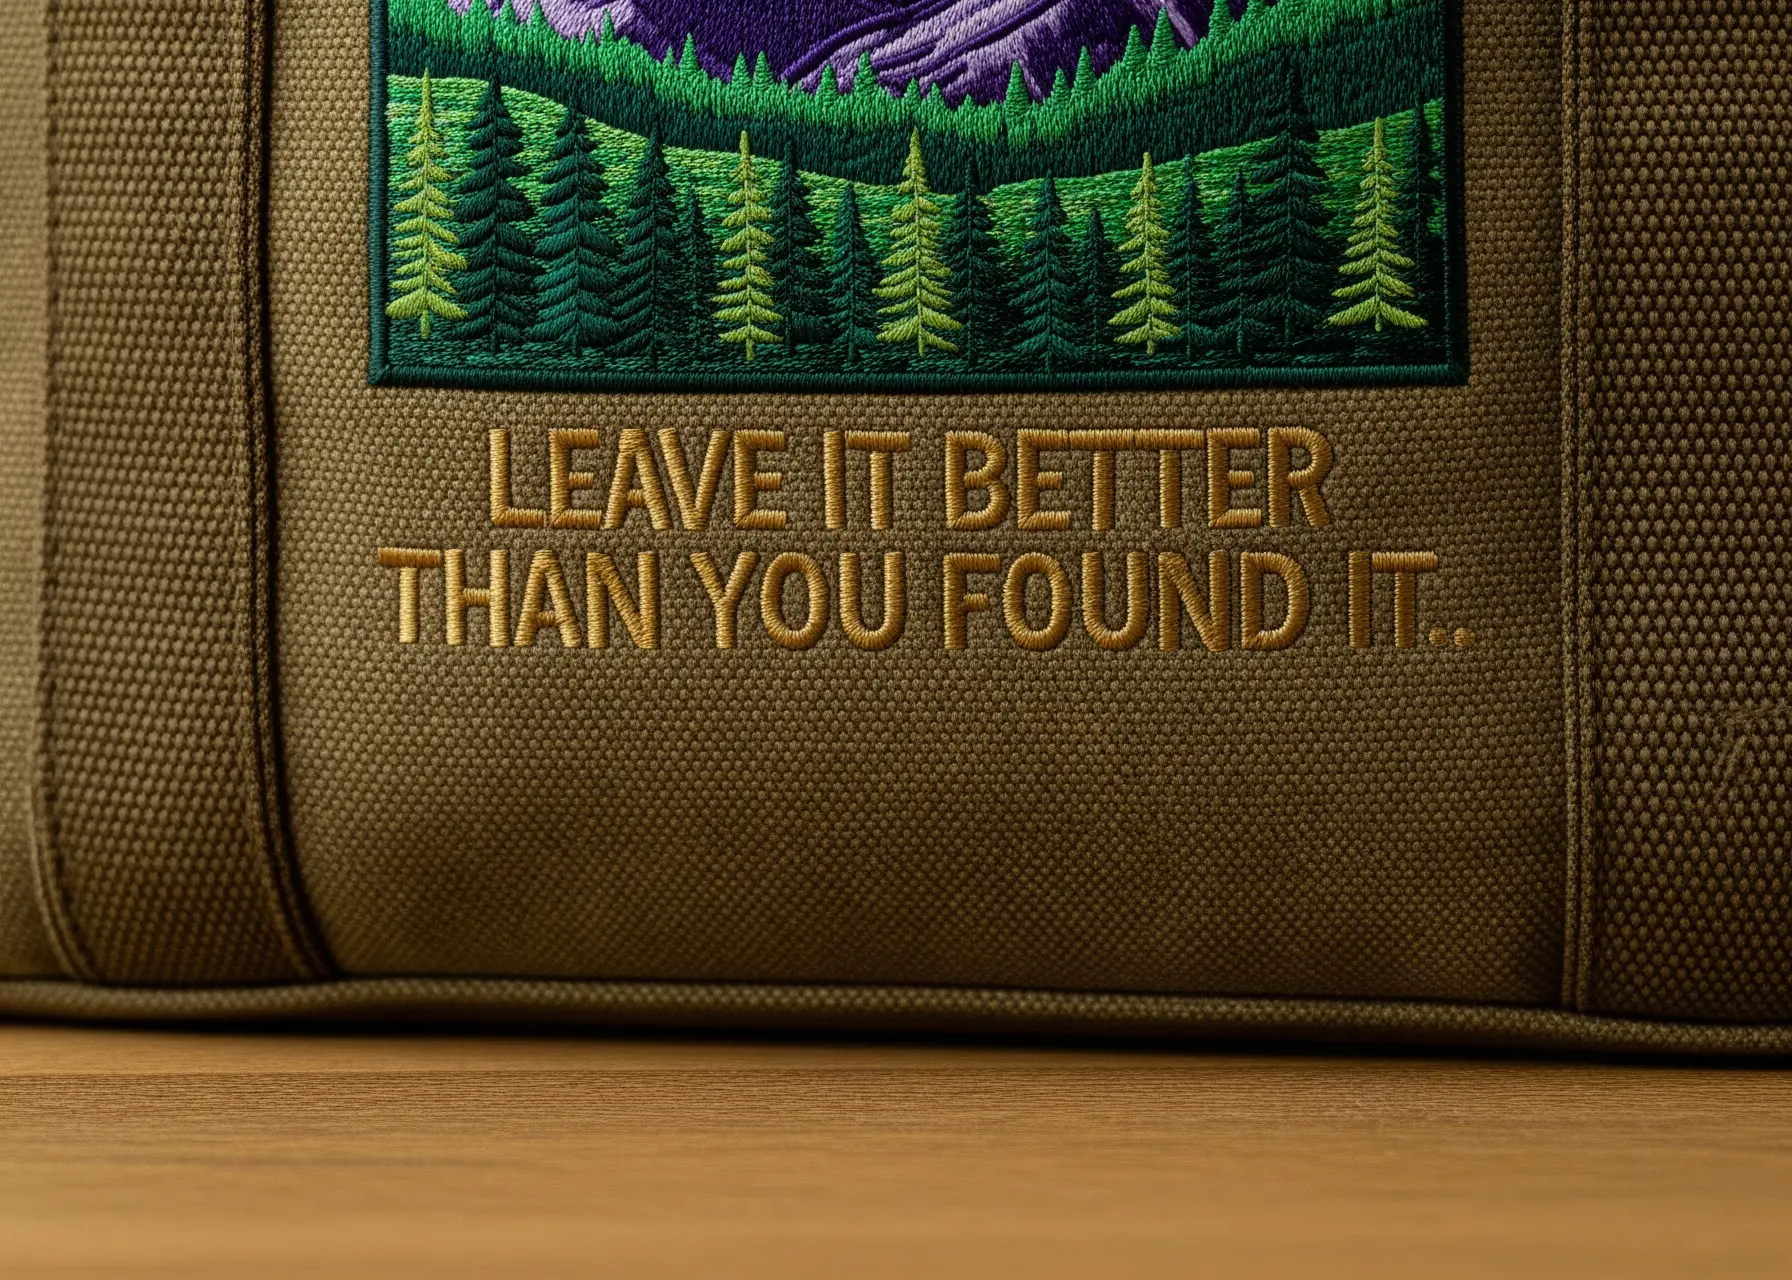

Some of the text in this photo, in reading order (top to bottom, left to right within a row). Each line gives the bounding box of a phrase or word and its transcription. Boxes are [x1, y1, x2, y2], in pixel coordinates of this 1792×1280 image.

[488, 425, 1333, 530] LEAVE IT BETTER
[377, 546, 1476, 652] THAN YOU FOUND IT..
